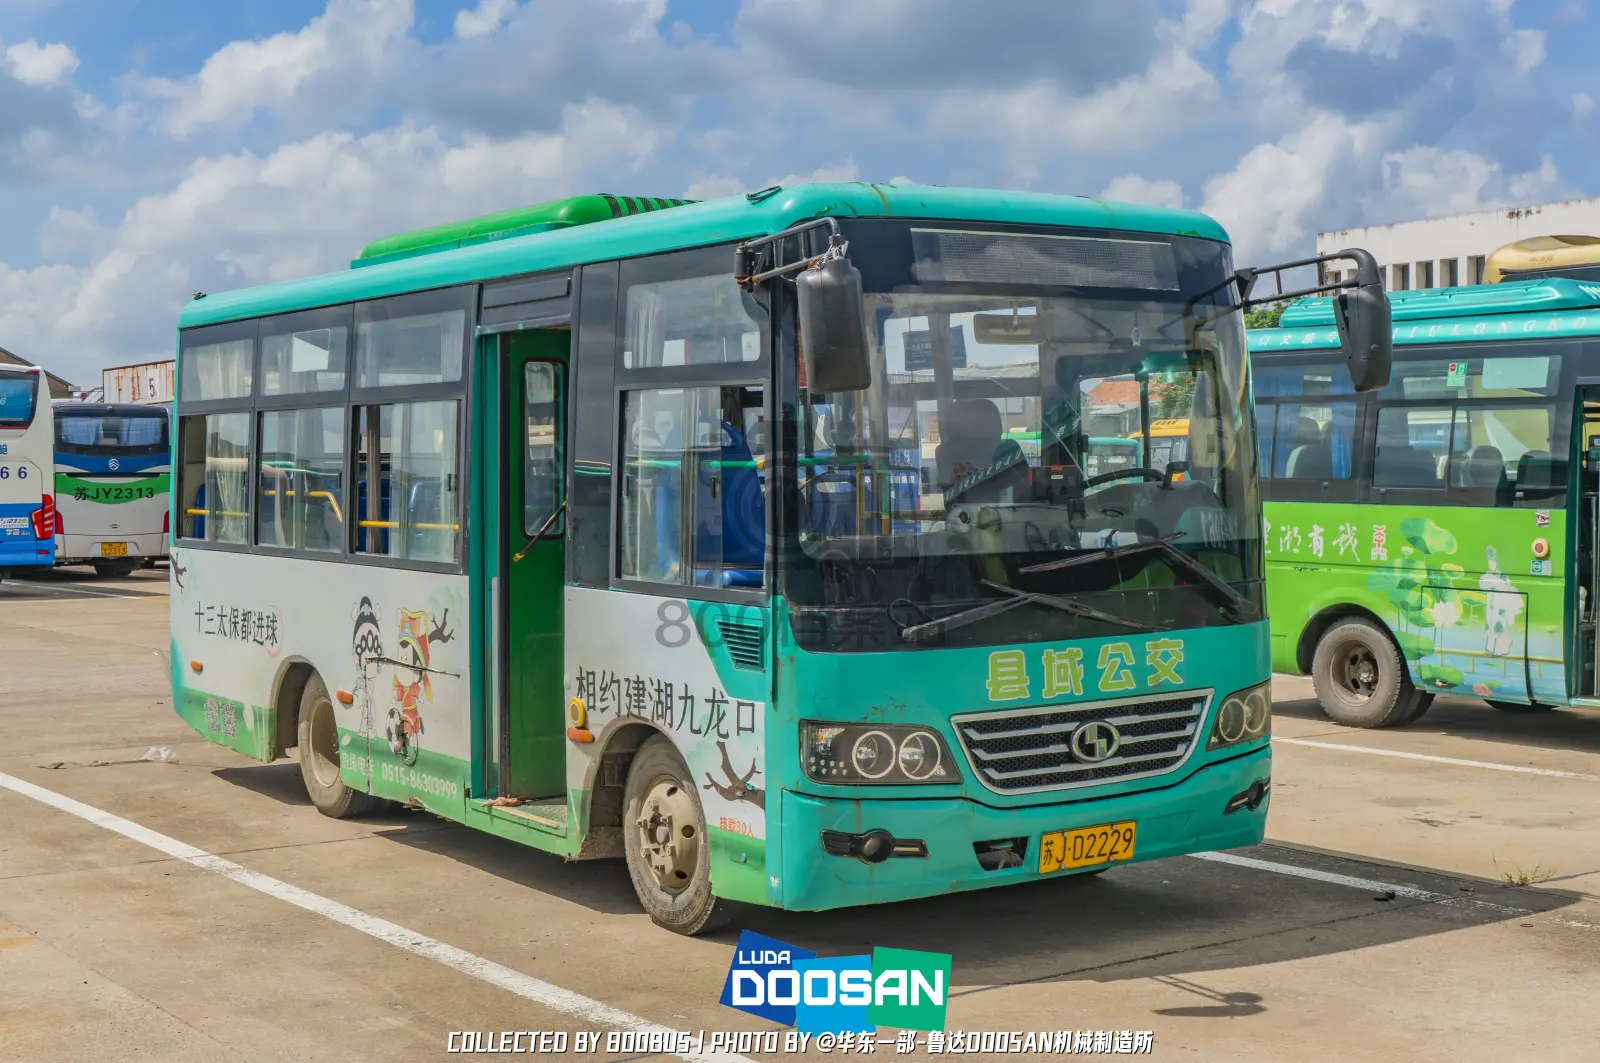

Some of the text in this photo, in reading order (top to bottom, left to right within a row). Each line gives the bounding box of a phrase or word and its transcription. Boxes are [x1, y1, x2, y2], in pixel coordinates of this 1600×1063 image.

[74, 486, 155, 501] 苏JY2313
[194, 601, 278, 648] 十三太保都进球
[985, 638, 1184, 701] 县域公交
[576, 666, 756, 740] 相约建湖九龙口
[381, 762, 457, 800] 0515-86303999
